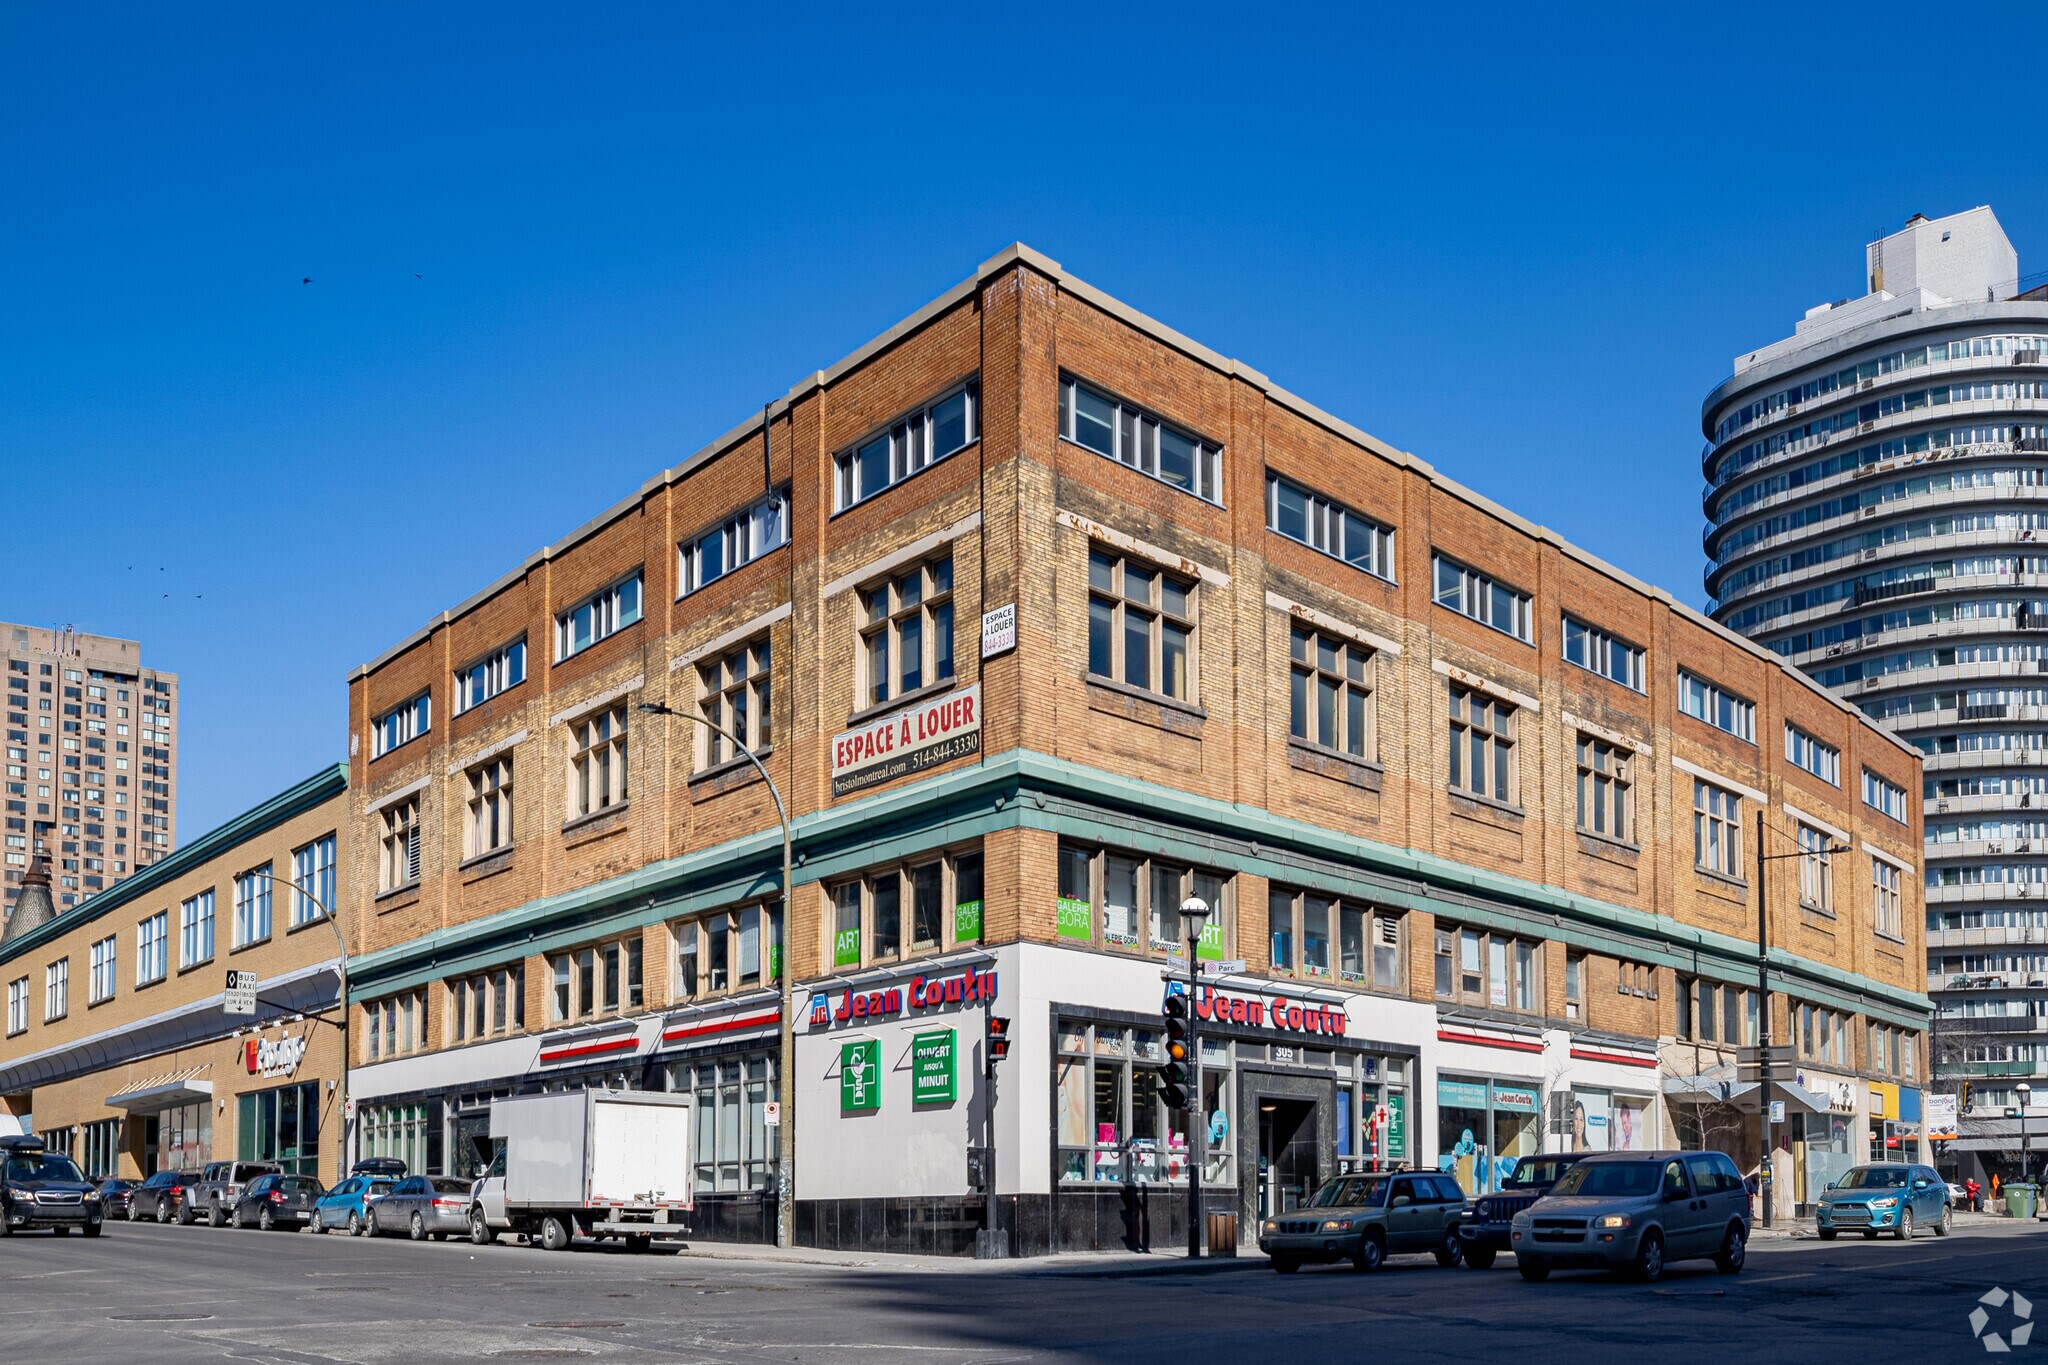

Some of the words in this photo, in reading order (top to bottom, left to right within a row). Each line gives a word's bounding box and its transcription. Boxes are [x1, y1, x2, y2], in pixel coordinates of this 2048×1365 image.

[985, 607, 1012, 625] ESPACE
[990, 618, 1014, 635] LOUER
[984, 630, 1014, 653] 844-3330
[837, 723, 894, 769] ESPACE
[900, 713, 912, 748] À
[918, 695, 975, 741] LOUER
[835, 762, 907, 794] bristolmontreal.com
[912, 733, 978, 770] 514-844-3330
[1057, 899, 1089, 915] GALERIE
[1057, 909, 1089, 929] GORA
[238, 974, 255, 982] BUS
[238, 982, 255, 990] TAXI
[835, 987, 903, 1022] Jean
[908, 965, 999, 1009] Coutu
[1196, 985, 1265, 1026] Jean
[1270, 996, 1347, 1036] Coutu
[917, 1044, 951, 1060] OUVERT
[1275, 1045, 1294, 1058] 305
[923, 1060, 944, 1071] JUSQU'À
[918, 1074, 950, 1088] MINUIT
[1500, 1092, 1514, 1103] Jean
[1928, 1097, 1955, 1105] bonjour
